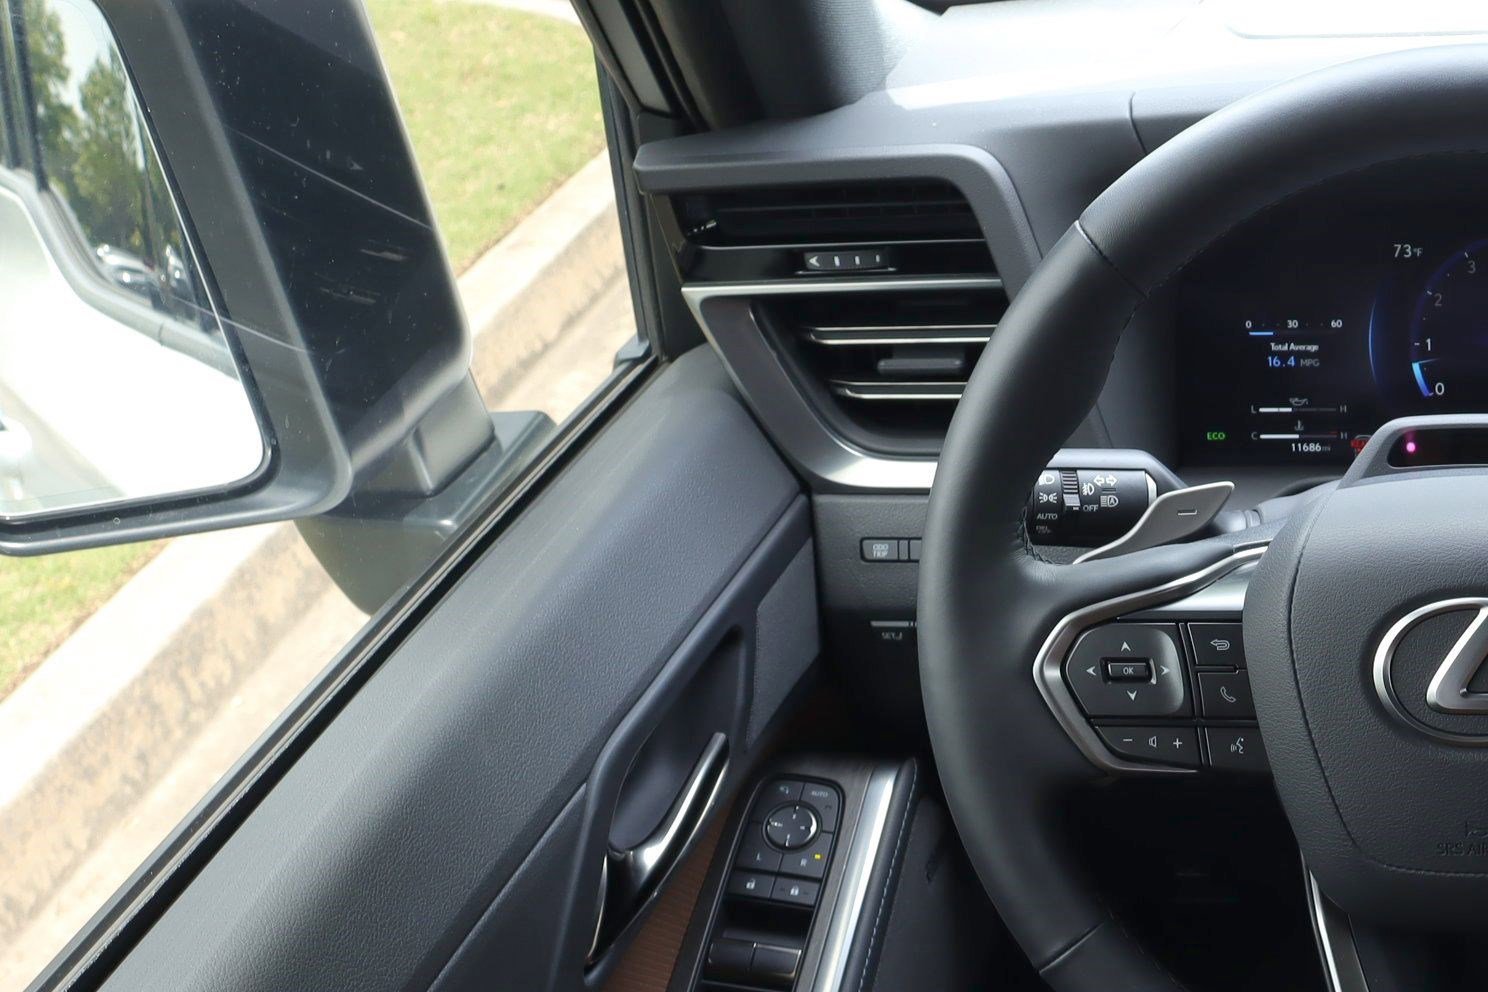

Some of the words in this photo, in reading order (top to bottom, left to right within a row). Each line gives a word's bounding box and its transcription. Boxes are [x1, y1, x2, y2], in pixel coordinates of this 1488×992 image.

[1467, 259, 1477, 274] 3
[1434, 292, 1443, 307] 2
[1287, 319, 1299, 329] 30
[1330, 319, 1343, 329] 60
[1270, 342, 1289, 351] Total
[1288, 342, 1320, 353] Average
[1267, 355, 1296, 368] 16.4
[1300, 358, 1320, 367] MPG
[1434, 382, 1445, 396] 0
[1206, 431, 1226, 441] ECO
[1291, 442, 1322, 452] 11686
[1082, 503, 1099, 512] OFF
[1122, 666, 1134, 675] OK
